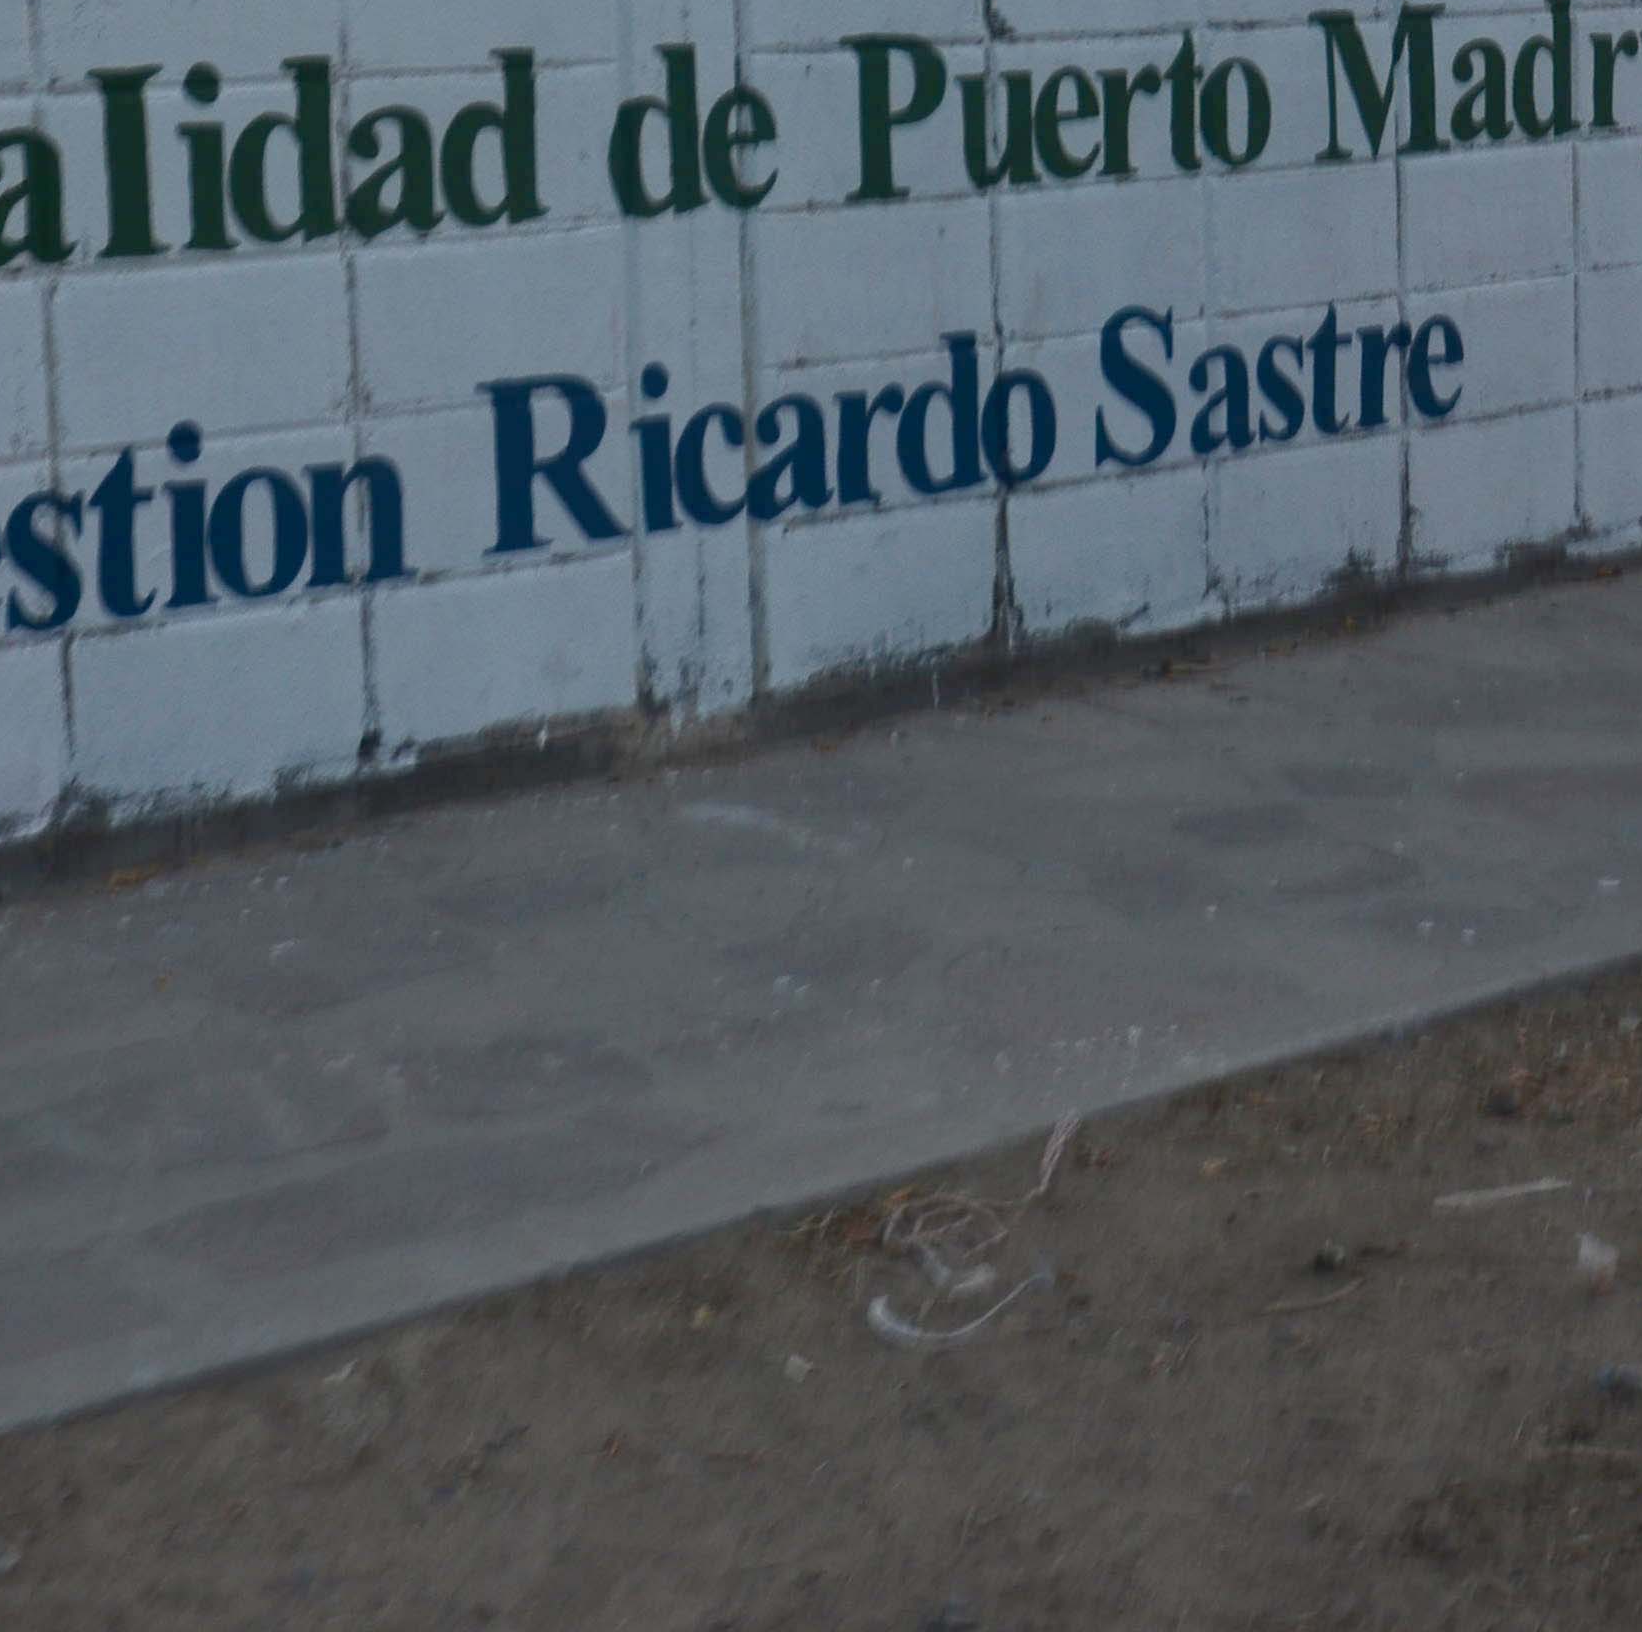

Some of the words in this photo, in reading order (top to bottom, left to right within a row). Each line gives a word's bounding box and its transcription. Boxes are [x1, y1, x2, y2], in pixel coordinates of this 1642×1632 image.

[607, 42, 778, 220] de
[840, 29, 1273, 204] Puerto
[477, 330, 1058, 557] Ricardo
[1094, 300, 1465, 469] Sastre
